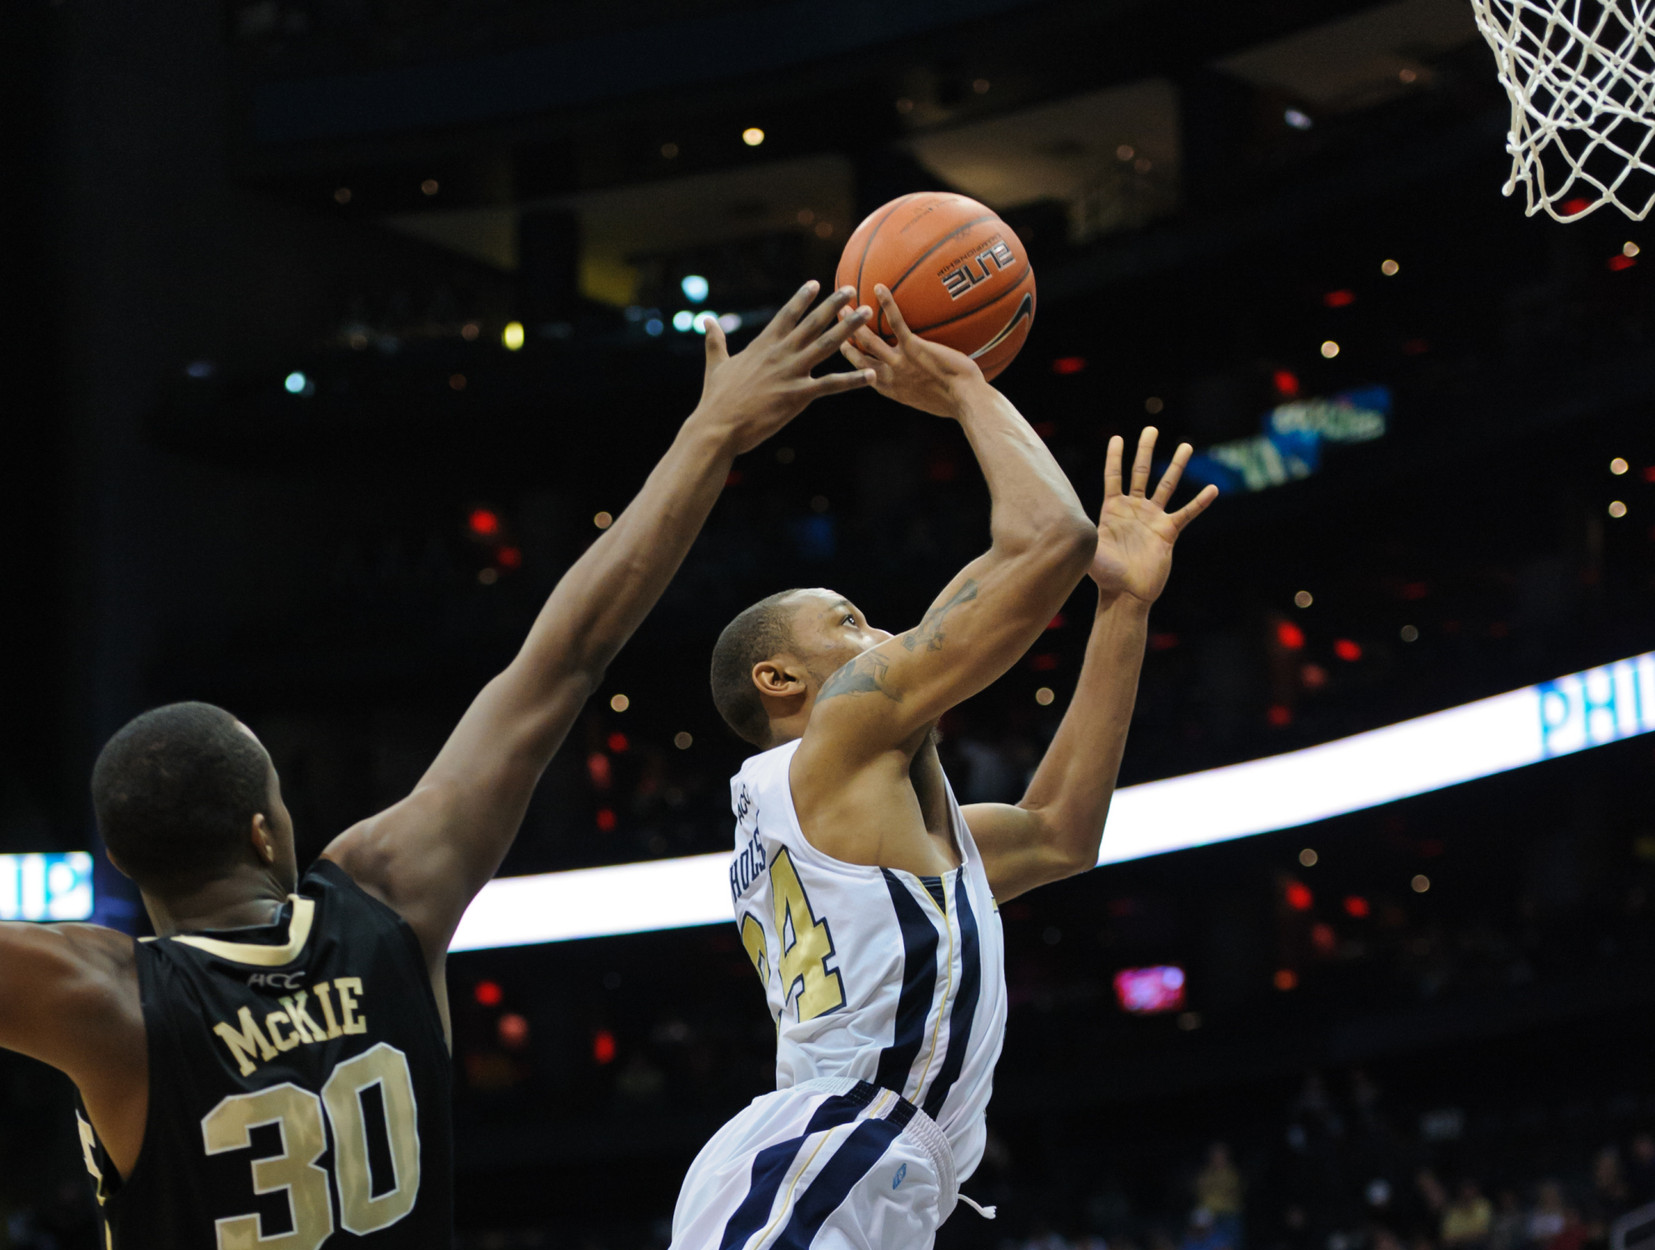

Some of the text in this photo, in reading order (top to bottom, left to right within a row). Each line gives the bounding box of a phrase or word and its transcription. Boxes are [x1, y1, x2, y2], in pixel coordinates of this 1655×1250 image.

[941, 239, 1016, 301] ELITE
[730, 810, 766, 902] HOLS
[249, 971, 305, 990] ACC
